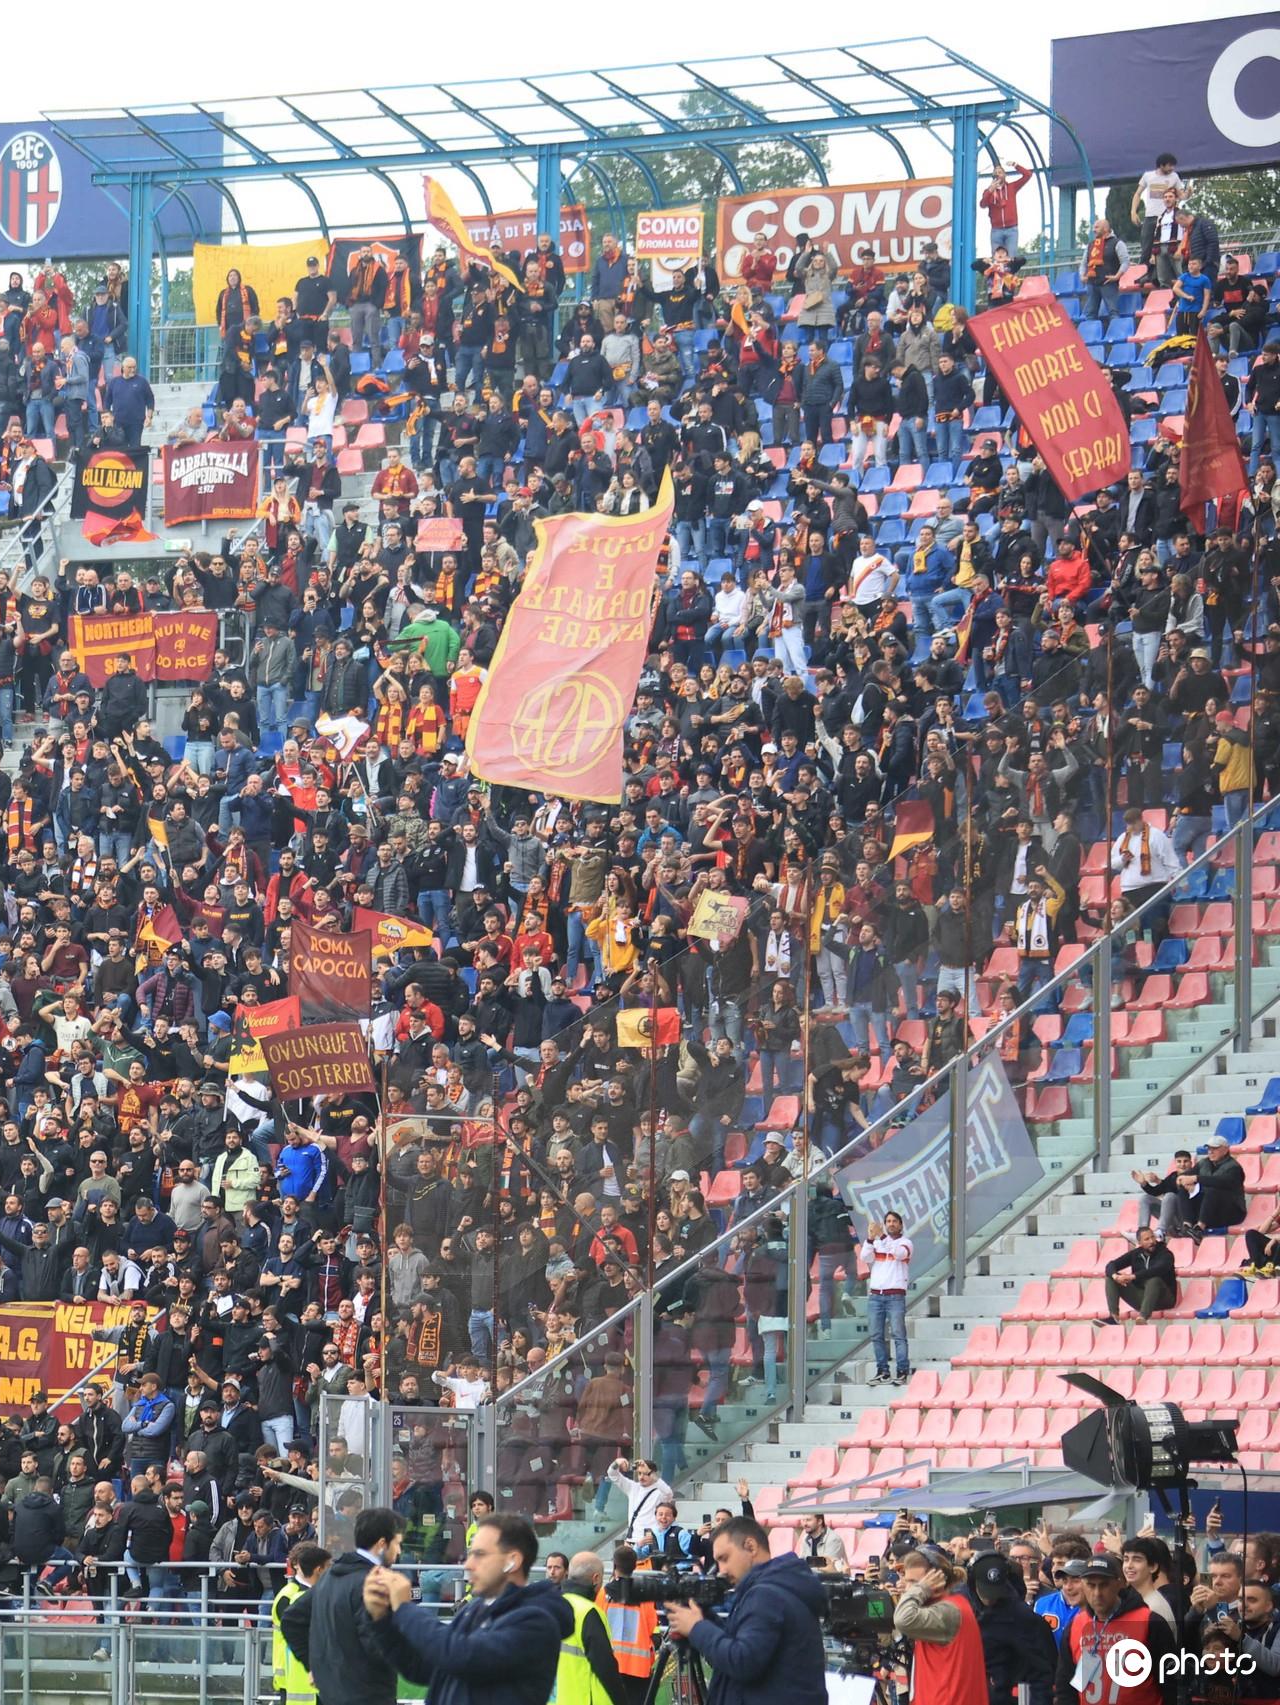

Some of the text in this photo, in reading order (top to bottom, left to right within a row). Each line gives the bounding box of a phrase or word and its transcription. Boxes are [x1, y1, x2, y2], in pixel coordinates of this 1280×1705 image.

[11, 135, 45, 160] BFC
[16, 160, 38, 169] 1909
[639, 217, 700, 235] COMO
[731, 185, 953, 244] COMO
[646, 239, 698, 249] ROMA CLUB
[853, 236, 933, 264] CLUB
[991, 303, 1062, 352] FINCHE
[1015, 344, 1084, 397] MORTE
[1039, 389, 1102, 440] NON CI
[171, 452, 248, 481] GARBATELLA
[1062, 433, 1121, 482] SEPARI
[107, 470, 143, 489] ALBANI
[84, 616, 153, 641] NORTHERN
[154, 622, 211, 641] NUN ME
[156, 655, 171, 669] DO
[310, 935, 353, 956] ROMA
[293, 956, 368, 979] CAPOCCIA
[270, 1032, 347, 1064] OVUNQUE
[277, 1063, 372, 1093] SOSTERREM
[55, 1306, 97, 1335] NEL
